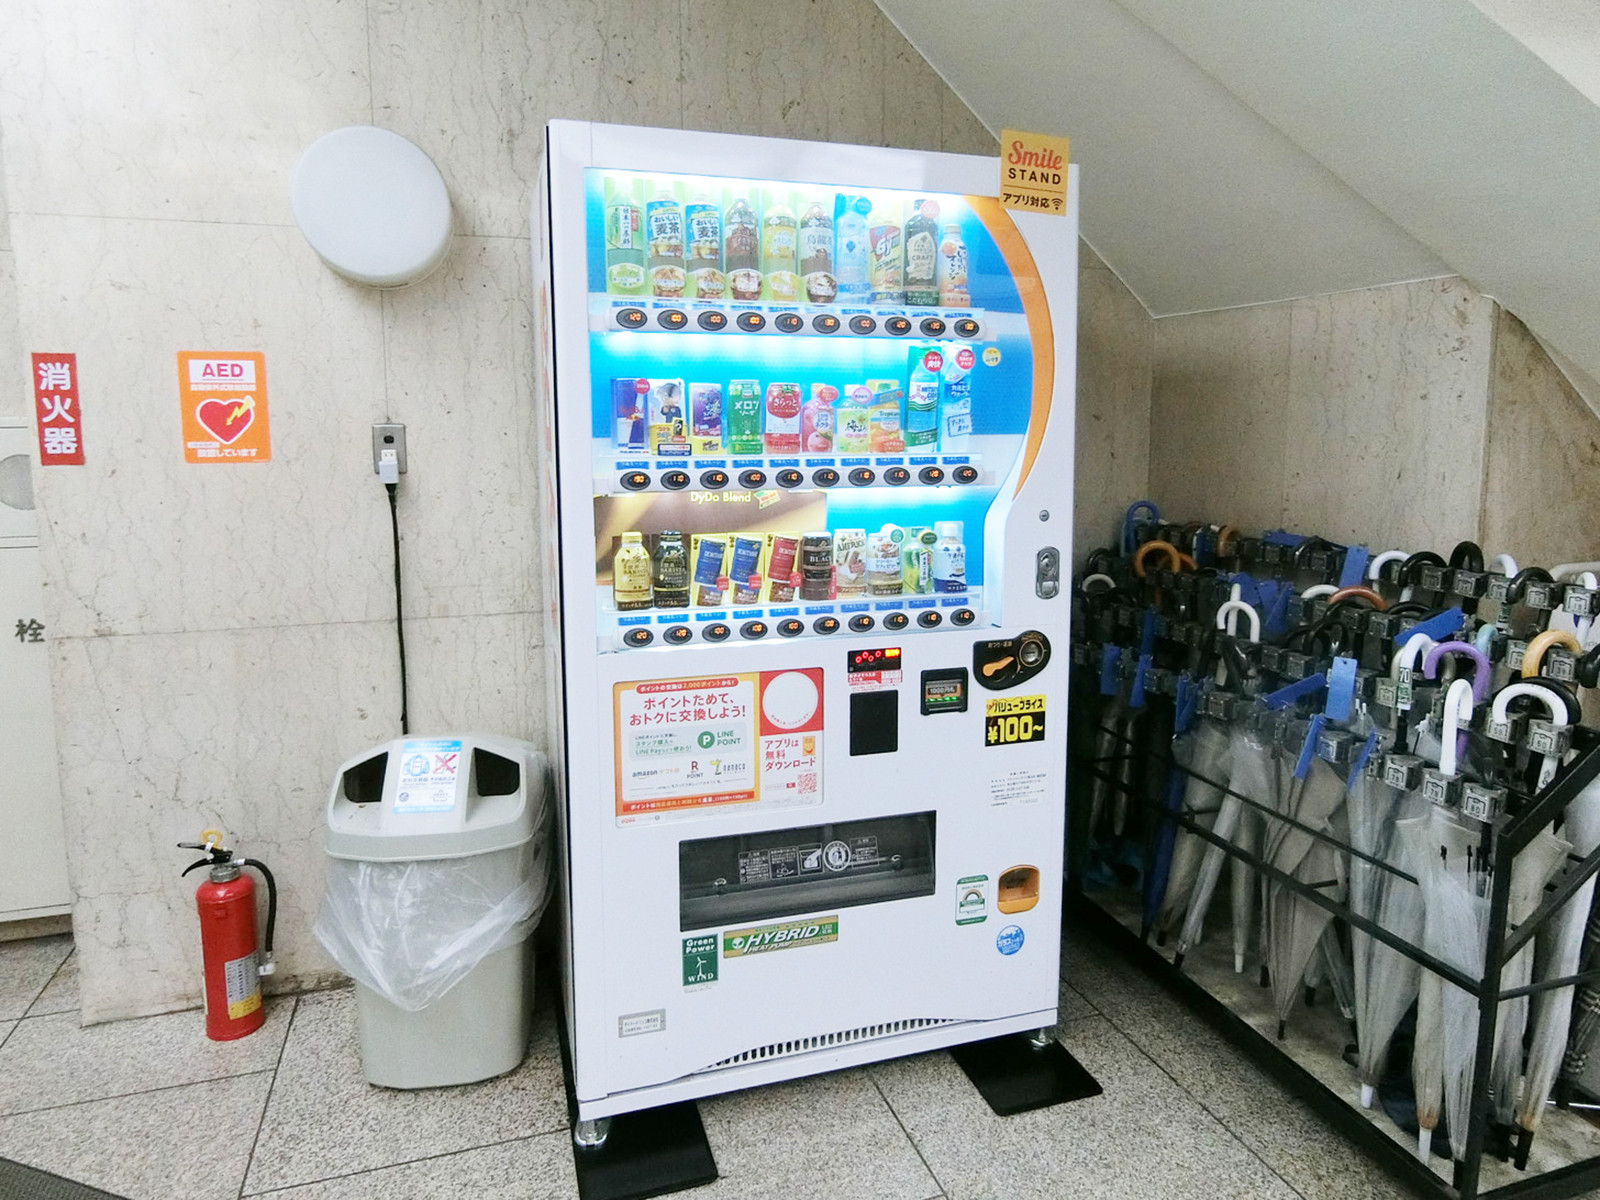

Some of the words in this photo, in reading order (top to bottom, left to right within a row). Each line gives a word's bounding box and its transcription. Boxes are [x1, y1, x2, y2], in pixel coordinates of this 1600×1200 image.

[1008, 140, 1063, 170] Smile
[1008, 167, 1061, 185] STAND
[1003, 192, 1050, 208] アプリ対応
[655, 222, 680, 236] 麦茶
[202, 363, 244, 377] AED
[38, 362, 78, 455] 消火器
[734, 400, 760, 410] メロン
[690, 491, 720, 504] DyDo
[722, 491, 752, 502] Blend
[15, 618, 46, 643] 栓
[717, 730, 734, 738] LINE
[717, 737, 741, 746] POINT
[765, 738, 799, 750] アプリは
[766, 749, 786, 760] 無料
[691, 761, 699, 771] R
[766, 757, 816, 772] ダウンロード
[632, 769, 658, 778] amazon
[686, 938, 714, 947] Green
[744, 925, 820, 953] HYBRID
[686, 945, 715, 954] Power
[750, 944, 769, 953] HEAT
[769, 941, 793, 950] PUMP
[688, 972, 714, 982] WIND
